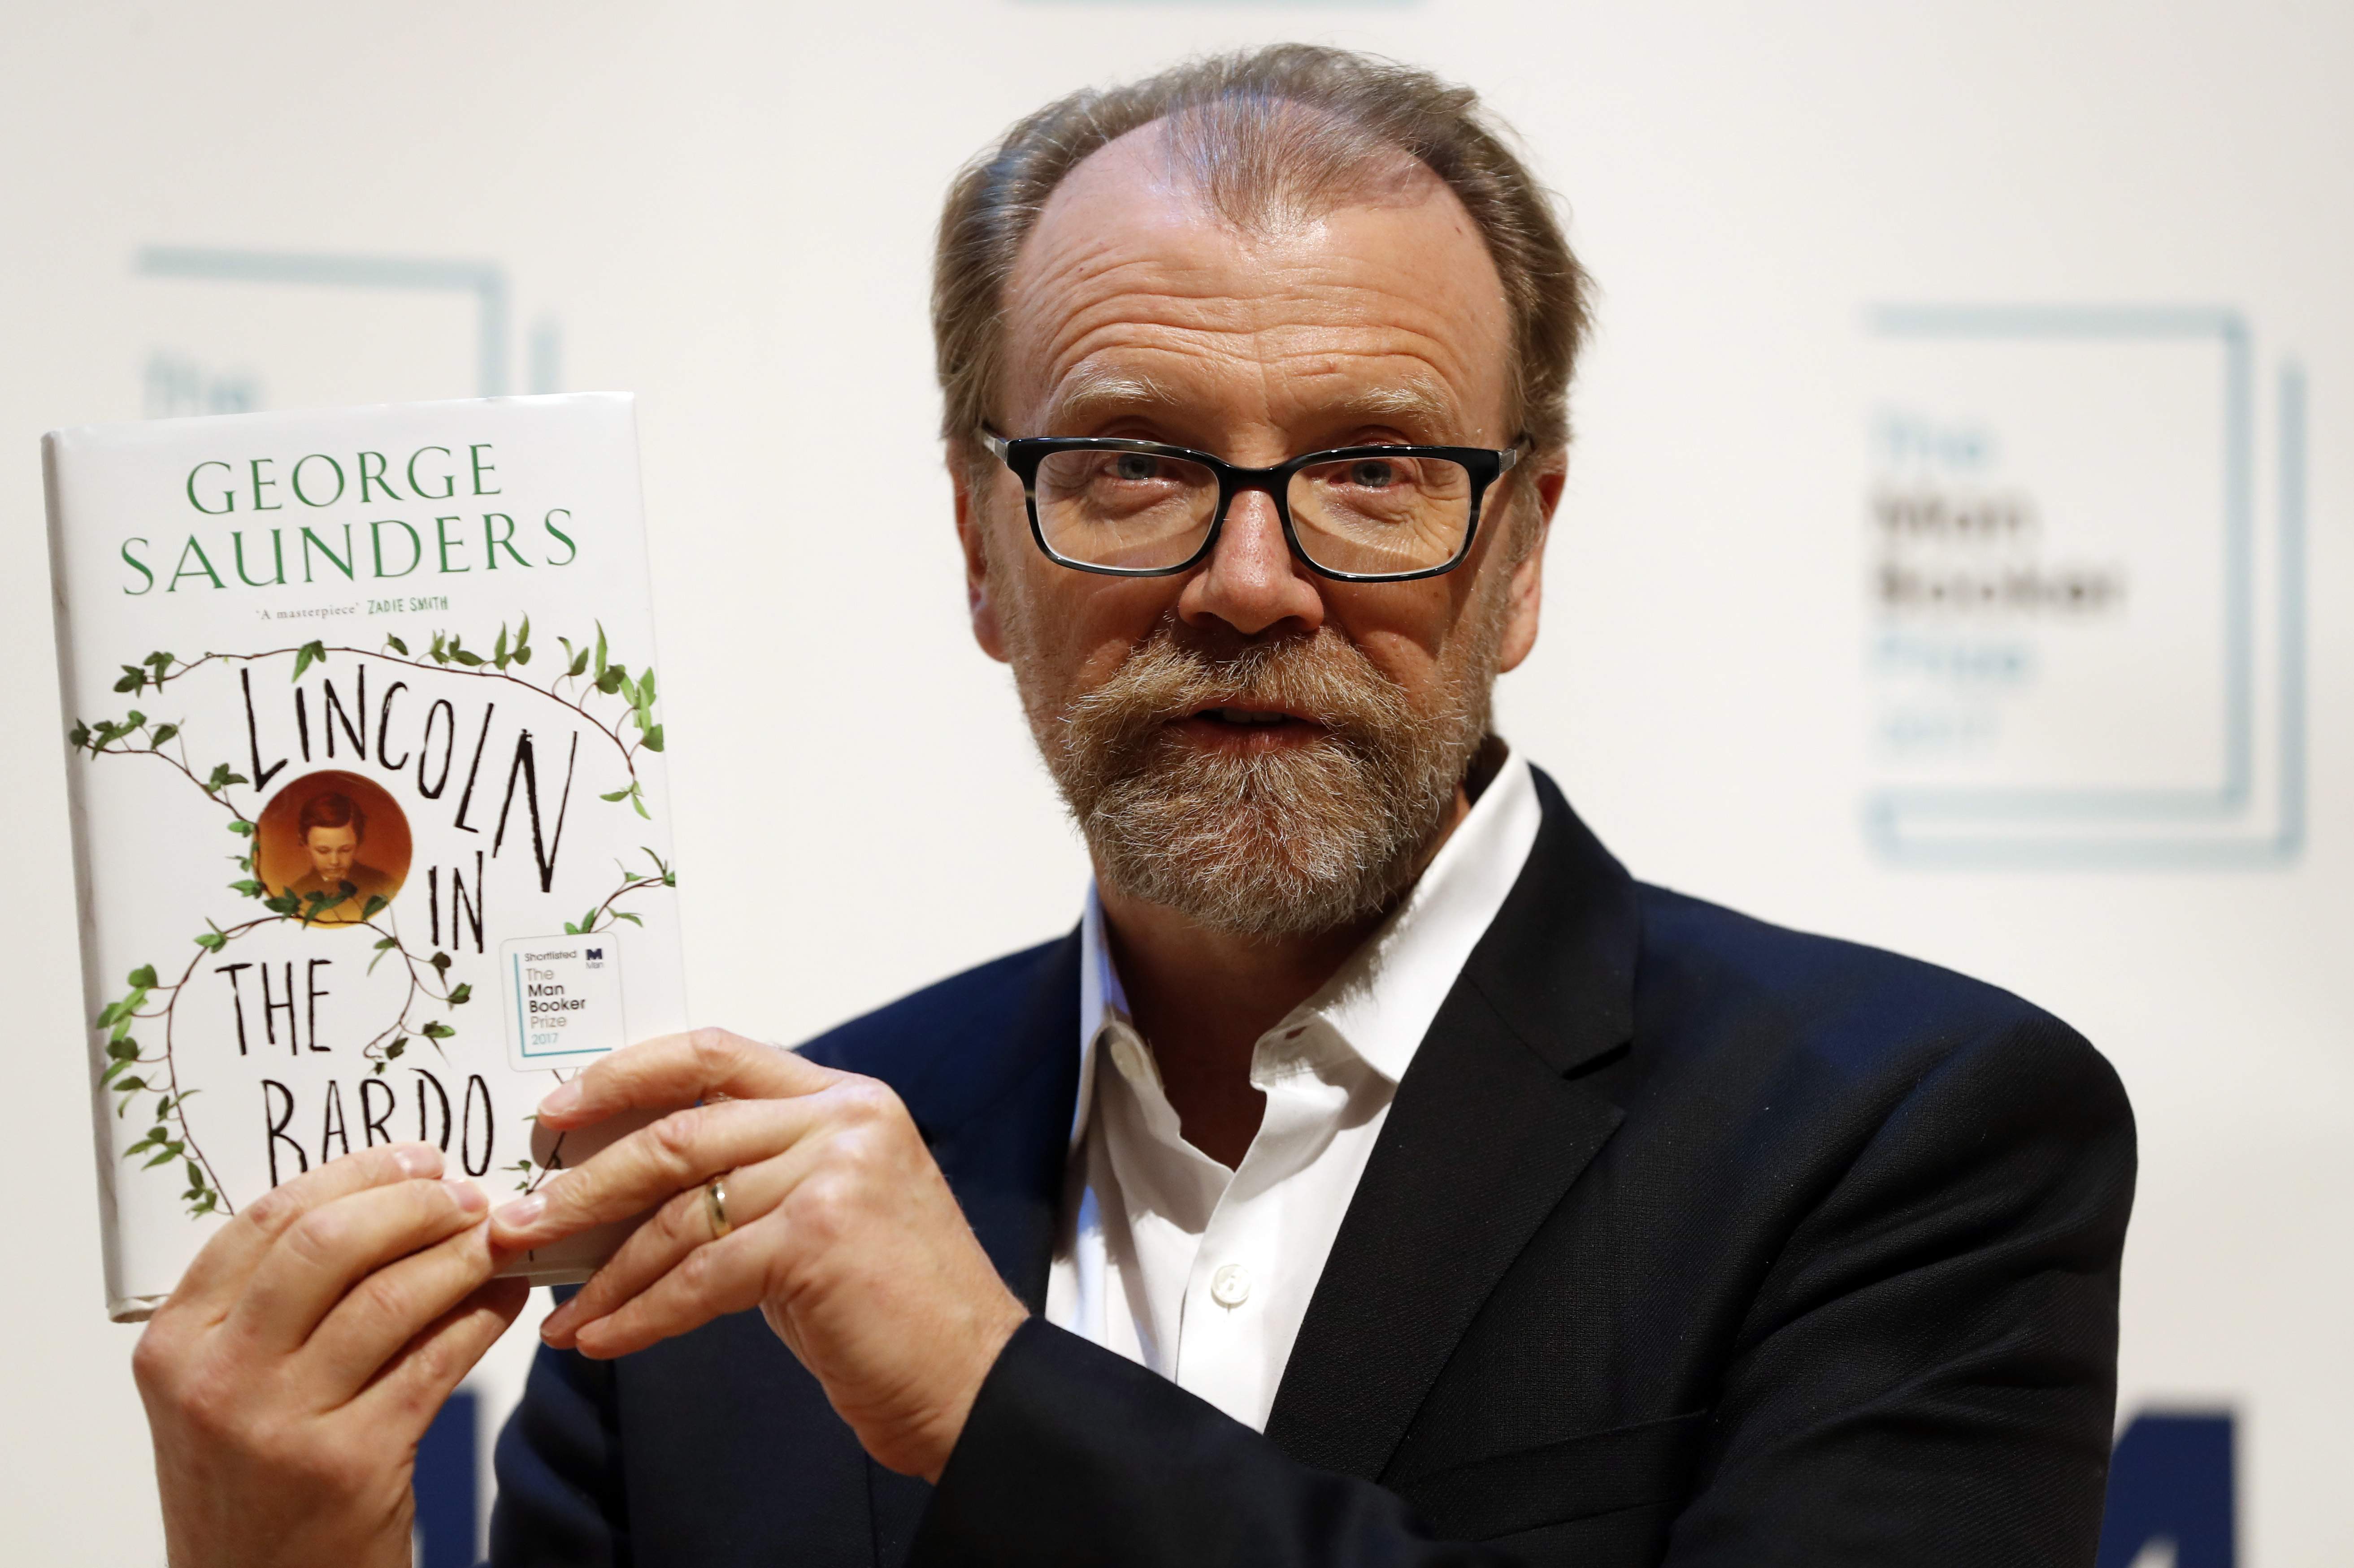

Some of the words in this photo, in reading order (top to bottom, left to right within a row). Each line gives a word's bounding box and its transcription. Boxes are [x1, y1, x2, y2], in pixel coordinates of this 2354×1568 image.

[186, 443, 501, 515] GEORGE
[120, 508, 577, 596] SAUNDERS
[367, 598, 404, 615] ZADIE
[410, 596, 448, 612] SMITH
[1876, 563, 2128, 616] Booker
[241, 664, 578, 893] LINCOLN
[428, 850, 484, 954] IN
[524, 950, 578, 962] Shortlisted
[526, 968, 554, 981] The
[528, 984, 565, 997] Man
[214, 958, 332, 1056] THE
[530, 998, 586, 1013] Booker
[530, 1016, 567, 1029] Prize
[532, 1032, 559, 1045] 2017
[261, 1068, 493, 1187] BARDO
